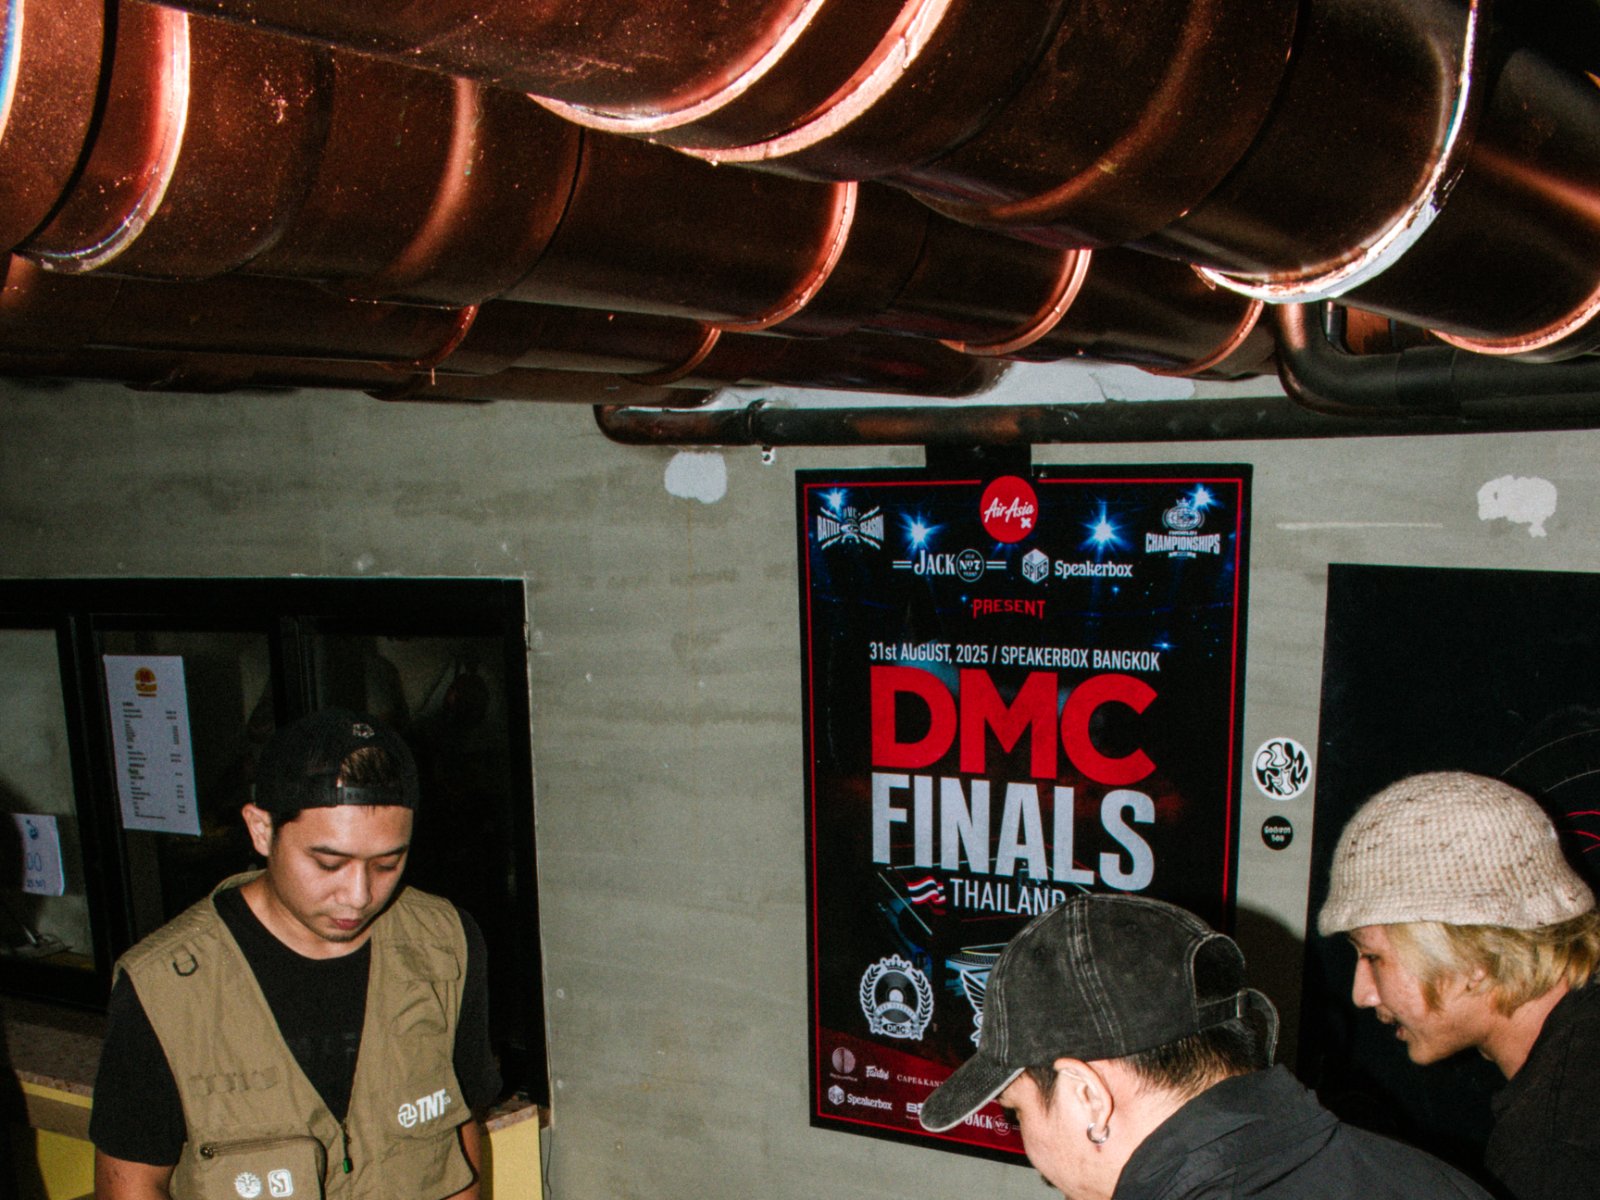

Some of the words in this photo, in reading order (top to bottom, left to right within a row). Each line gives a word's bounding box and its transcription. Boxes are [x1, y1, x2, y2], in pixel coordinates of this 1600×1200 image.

[1145, 532, 1221, 555] CHAMPIONSHIPS
[913, 548, 956, 576] JACK
[1054, 560, 1134, 580] Speakerbox
[972, 599, 1046, 619] PRESENT
[869, 642, 897, 661] 31st
[900, 643, 953, 664] AUGUST,
[956, 645, 988, 664] 2025
[1001, 646, 1089, 669] SPEAKERBOX
[1093, 649, 1161, 672] BANGKOK
[870, 664, 1158, 786] DMC
[871, 772, 1156, 892] FINALS
[415, 1088, 446, 1123] TNT
[847, 1093, 893, 1111] Speakerbox
